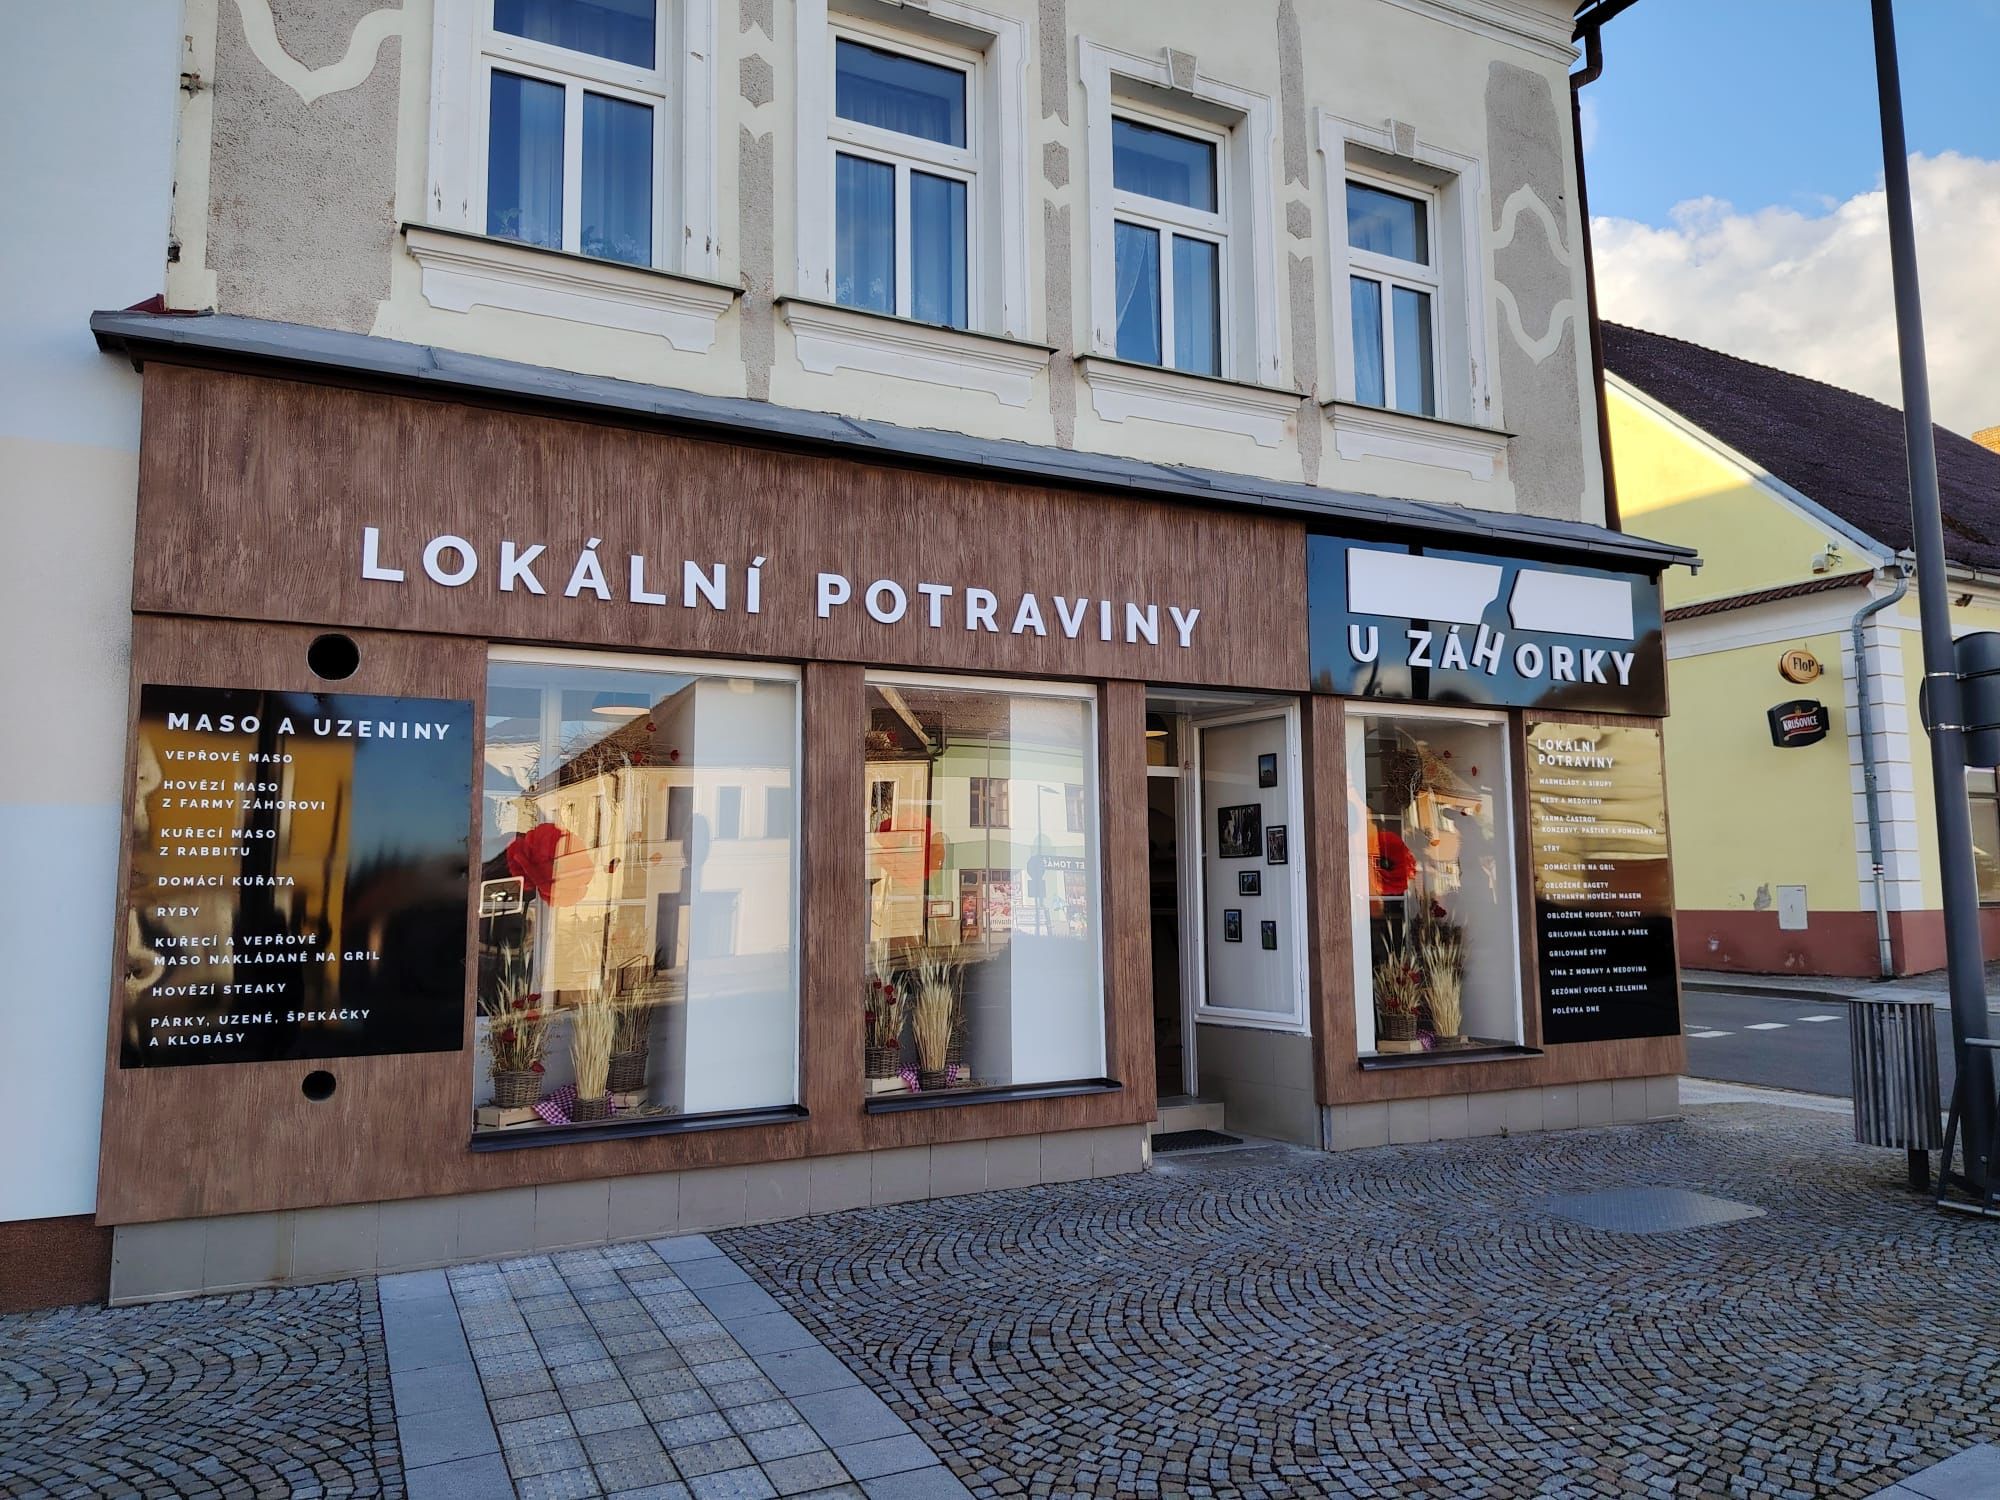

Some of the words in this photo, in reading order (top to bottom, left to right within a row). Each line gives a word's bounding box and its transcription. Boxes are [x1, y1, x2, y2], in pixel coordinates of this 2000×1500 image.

[362, 527, 767, 613] LOKÁLNÍ
[816, 572, 1201, 647] POTRAVINY
[1349, 624, 1378, 662] U
[1406, 623, 1634, 686] ZÁHORKY
[168, 712, 261, 733] MASO
[278, 717, 296, 735] A
[313, 719, 450, 740] UZENINY
[1783, 715, 1818, 731] KRUŠOVICE
[1538, 738, 1596, 752] LOKÁLNÍ
[165, 750, 240, 762] VEPŘOVÉ
[248, 753, 293, 764] MASO
[1538, 754, 1613, 768] POTRAVINY
[164, 779, 226, 791] HOVĚZÍ
[234, 781, 278, 792] MASO
[162, 798, 171, 808] Z
[180, 799, 235, 809] FARMY
[242, 798, 325, 811] ZÁHOROVI
[161, 827, 223, 838] KUŘECÍ
[231, 829, 277, 839] MASO
[159, 847, 169, 856] Z
[177, 847, 250, 856] RABBITU
[158, 874, 223, 886] DOMÁCÍ
[232, 875, 295, 886] KUŘATA
[157, 907, 200, 917] RYBY
[1547, 911, 1582, 919] OBLOŽENÉ
[155, 935, 218, 947] KUŘECÍ
[226, 937, 235, 945] A
[243, 933, 317, 945] VEPŘOVÉ
[1548, 929, 1586, 938] GRILOVANÁ
[1589, 928, 1619, 936] KLOBÁSA
[1628, 928, 1648, 936] PÁREK
[154, 955, 200, 966] MASO
[209, 952, 308, 965] NAKLÁDANÉ
[316, 952, 336, 962] NA
[344, 951, 380, 961] GRIL
[1549, 949, 1587, 957] GRILOVANÉ
[1550, 968, 1566, 976] VÍNA
[152, 984, 215, 997] HOVĚZÍ
[223, 983, 286, 995] STEAKY
[1552, 987, 1581, 995] SEZÓNNÍ
[1616, 984, 1647, 992] ZELENINA
[151, 1016, 211, 1028] PÁRKY,
[219, 1012, 278, 1025] UZENÉ,
[286, 1008, 370, 1023] ŠPEKÁČKY
[149, 1037, 159, 1046] A
[168, 1032, 245, 1045] KLOBÁSY
